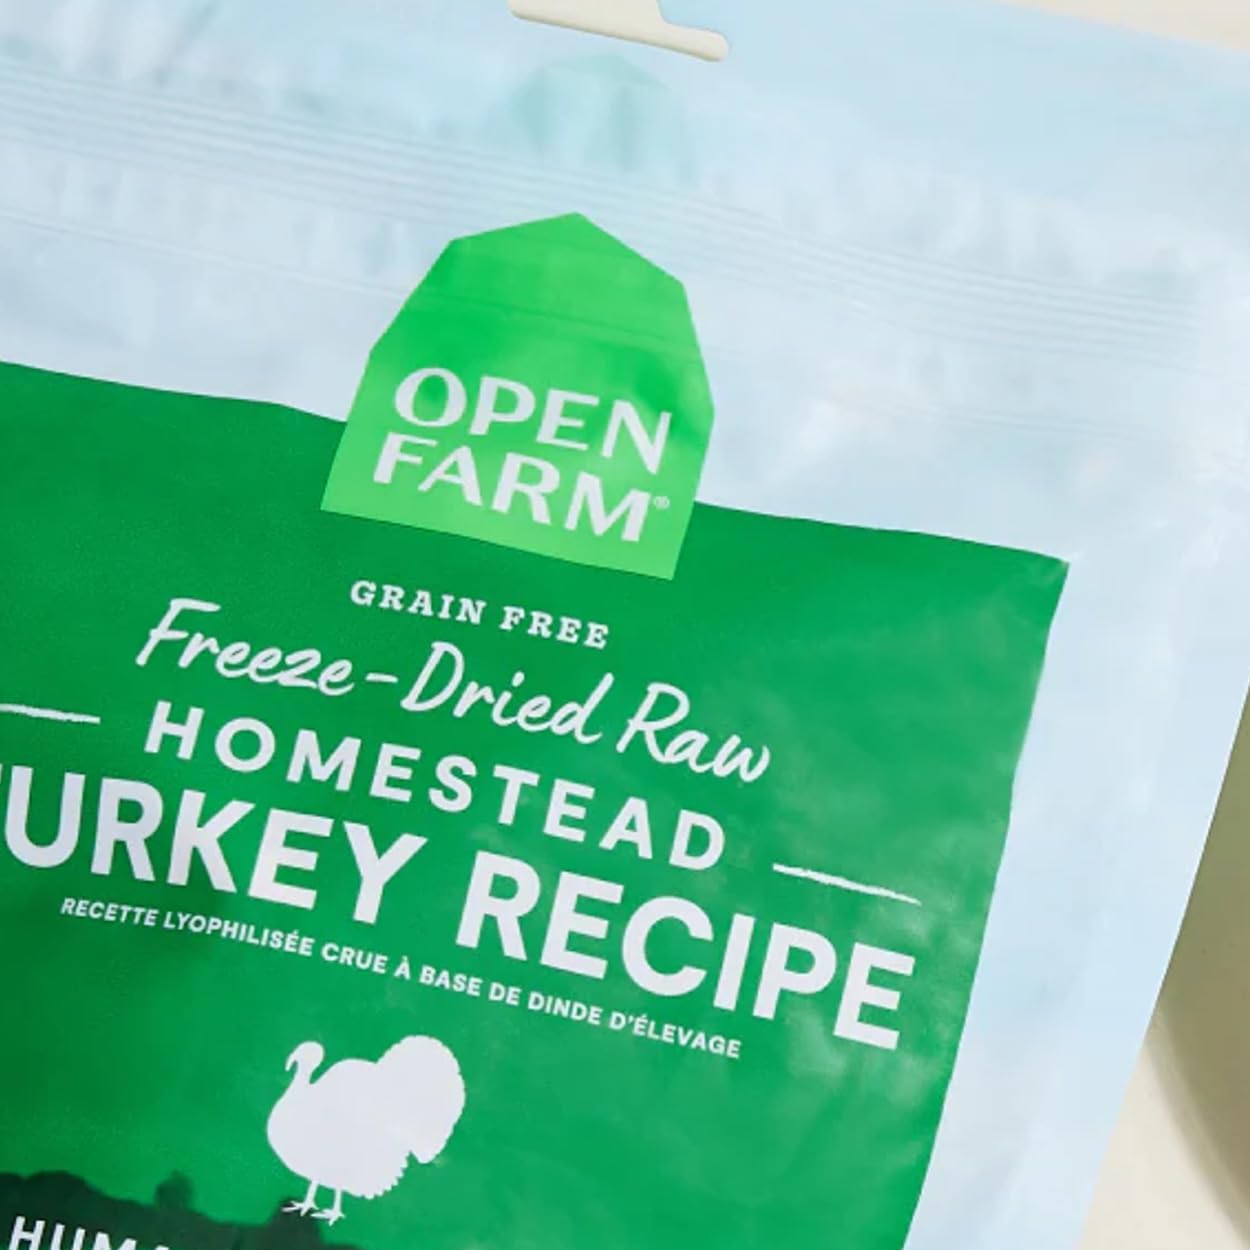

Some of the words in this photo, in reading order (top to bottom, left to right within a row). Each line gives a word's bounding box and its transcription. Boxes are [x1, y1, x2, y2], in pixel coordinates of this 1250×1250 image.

[394, 367, 672, 475] OPEN
[373, 432, 670, 543] FARM®
[350, 580, 486, 625] GRAIN
[500, 606, 609, 649] FREE
[135, 598, 613, 746] Freeze-Dried
[616, 683, 770, 783] Raw
[144, 700, 725, 870] HOMESTEAD
[0, 763, 428, 925] URKEY
[456, 851, 916, 1050] RECIPE
[60, 898, 159, 926] RECETTE
[163, 911, 315, 957] LYOPHILISÉE
[321, 942, 388, 974] CRUE
[394, 956, 412, 980] À
[419, 965, 483, 997] BASE
[488, 981, 522, 1006] DE
[527, 991, 603, 1025] DINDE
